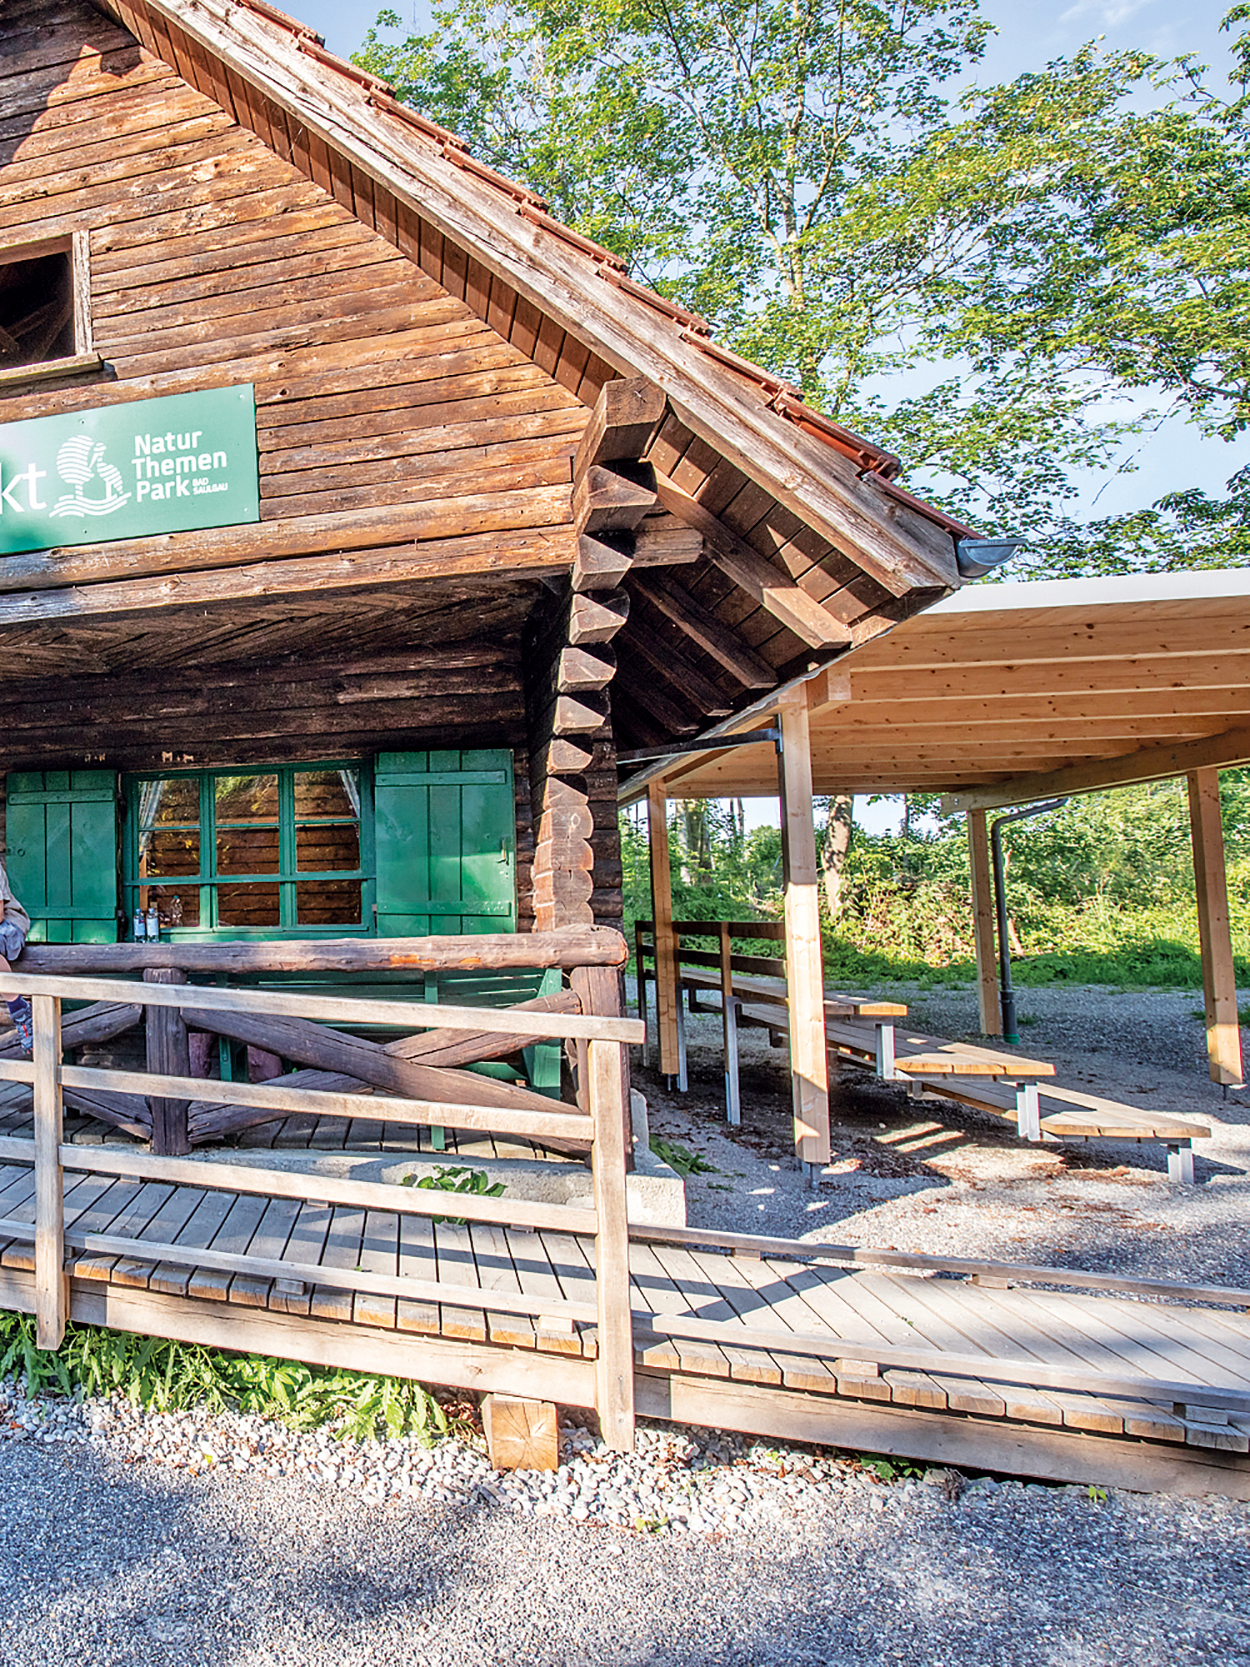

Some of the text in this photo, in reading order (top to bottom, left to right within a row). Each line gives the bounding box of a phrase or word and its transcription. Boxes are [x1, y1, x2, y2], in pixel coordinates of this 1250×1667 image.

[134, 431, 203, 456] Natur
[131, 451, 227, 479] Themen
[136, 475, 191, 502] Park
[192, 477, 209, 487] BAD
